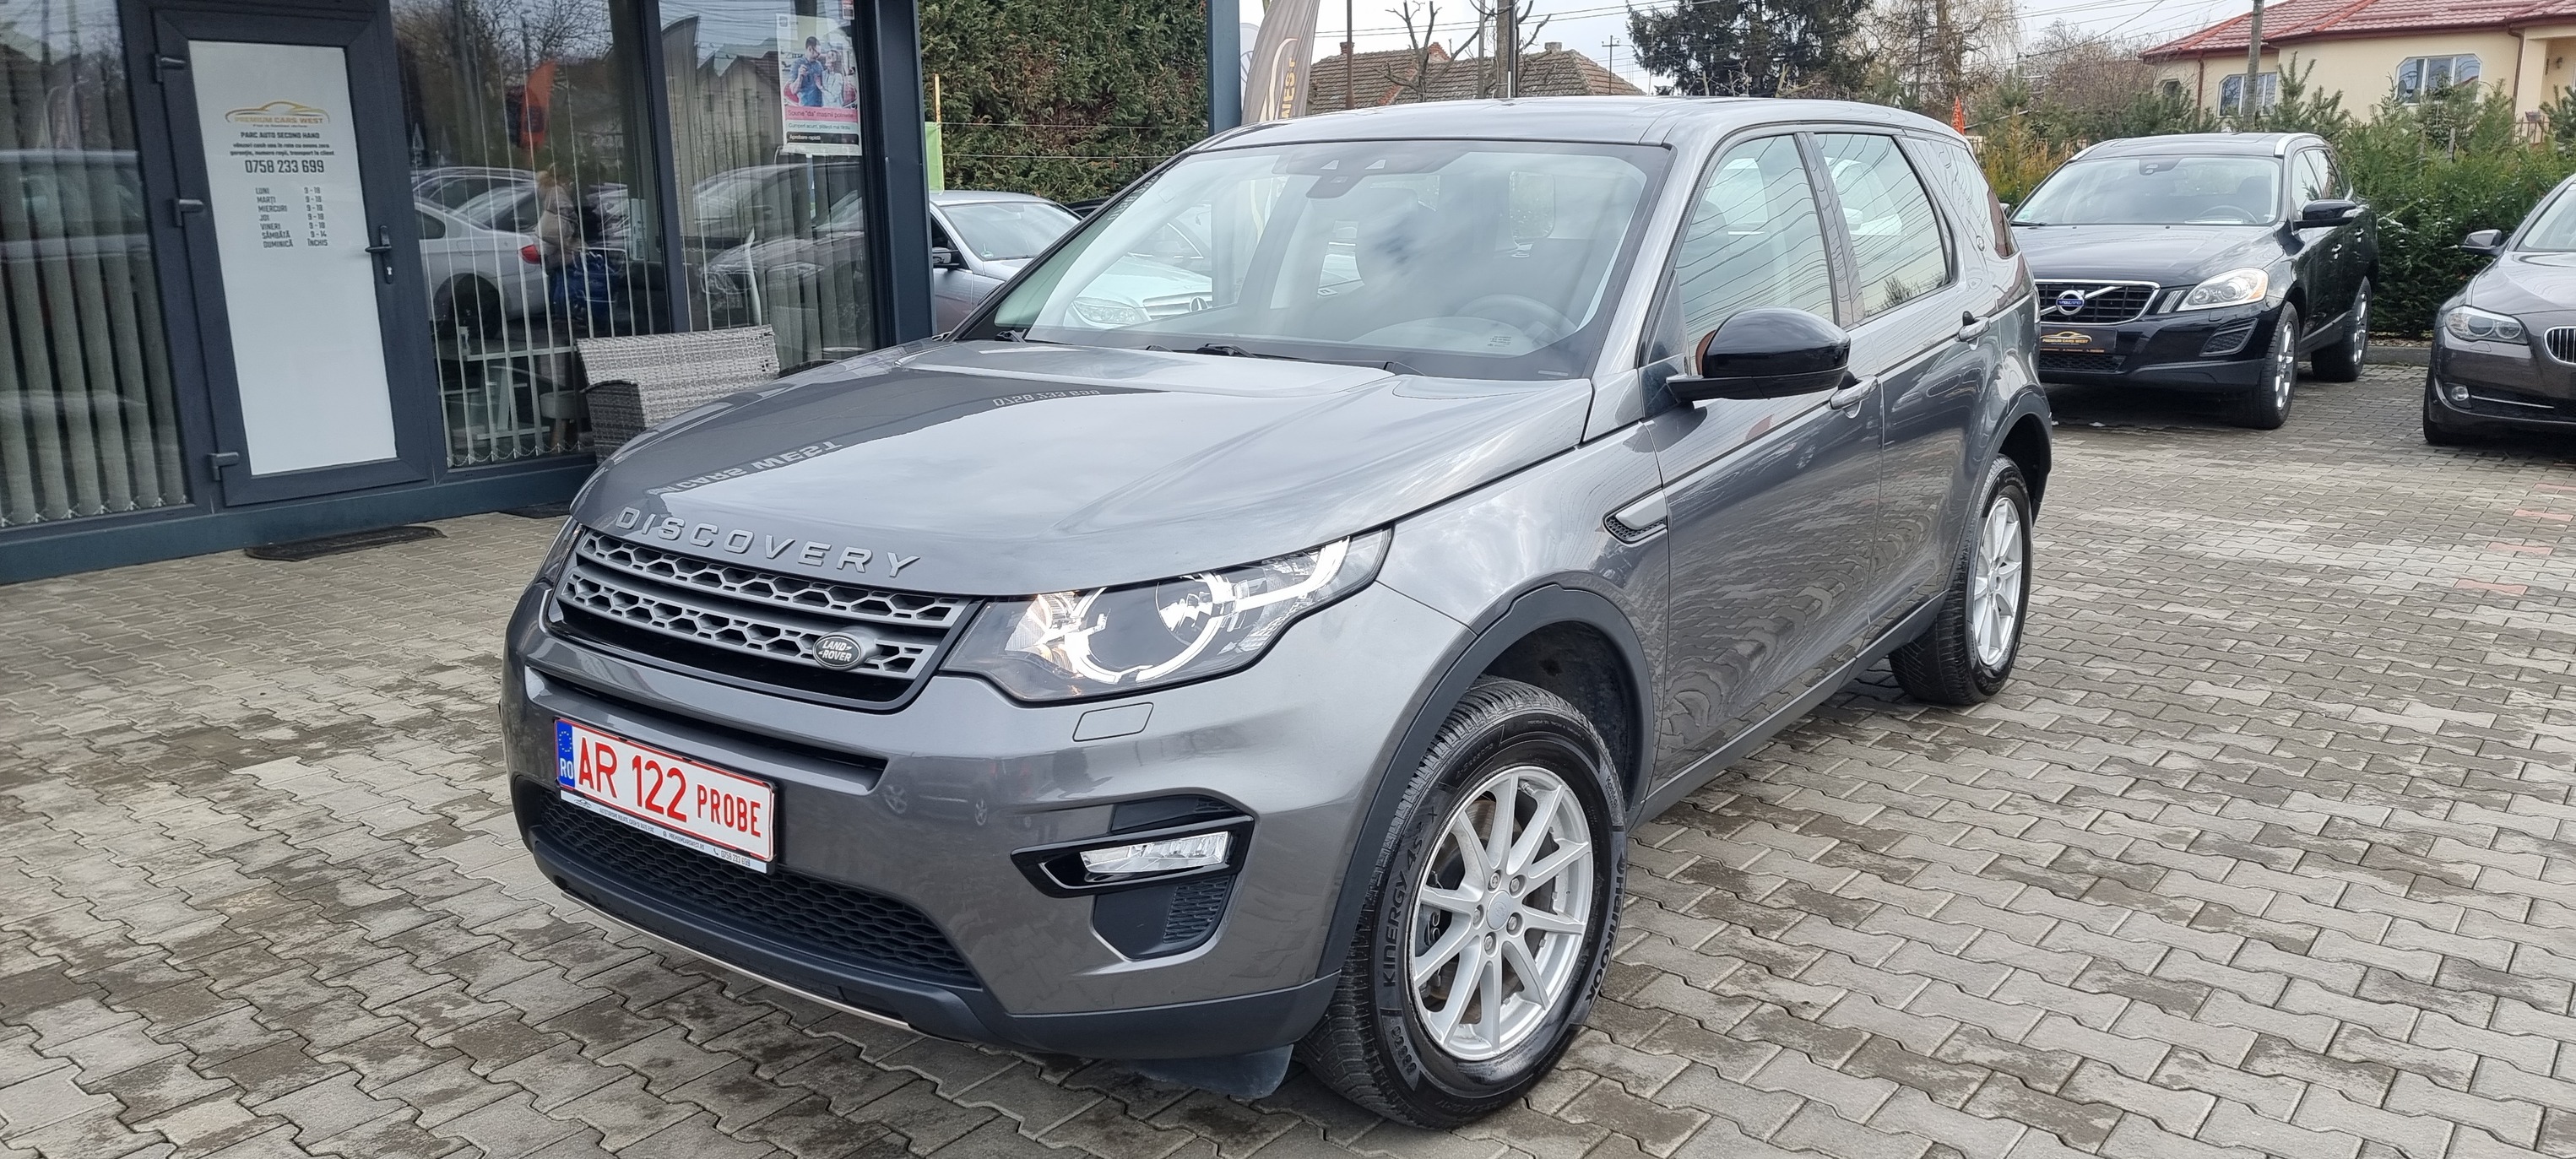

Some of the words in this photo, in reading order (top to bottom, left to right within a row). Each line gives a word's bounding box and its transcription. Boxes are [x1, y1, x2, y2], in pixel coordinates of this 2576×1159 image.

[245, 160, 274, 173] 0758
[277, 160, 299, 173] 233
[301, 160, 324, 173] 699
[615, 506, 921, 578] DISCOVERY
[822, 640, 847, 651] LAND
[822, 649, 852, 662] ROVER
[560, 757, 574, 780] RO
[578, 736, 618, 799] AR
[632, 755, 687, 823] 122
[697, 783, 762, 837] PROBE
[1382, 870, 1407, 987] KINERGY
